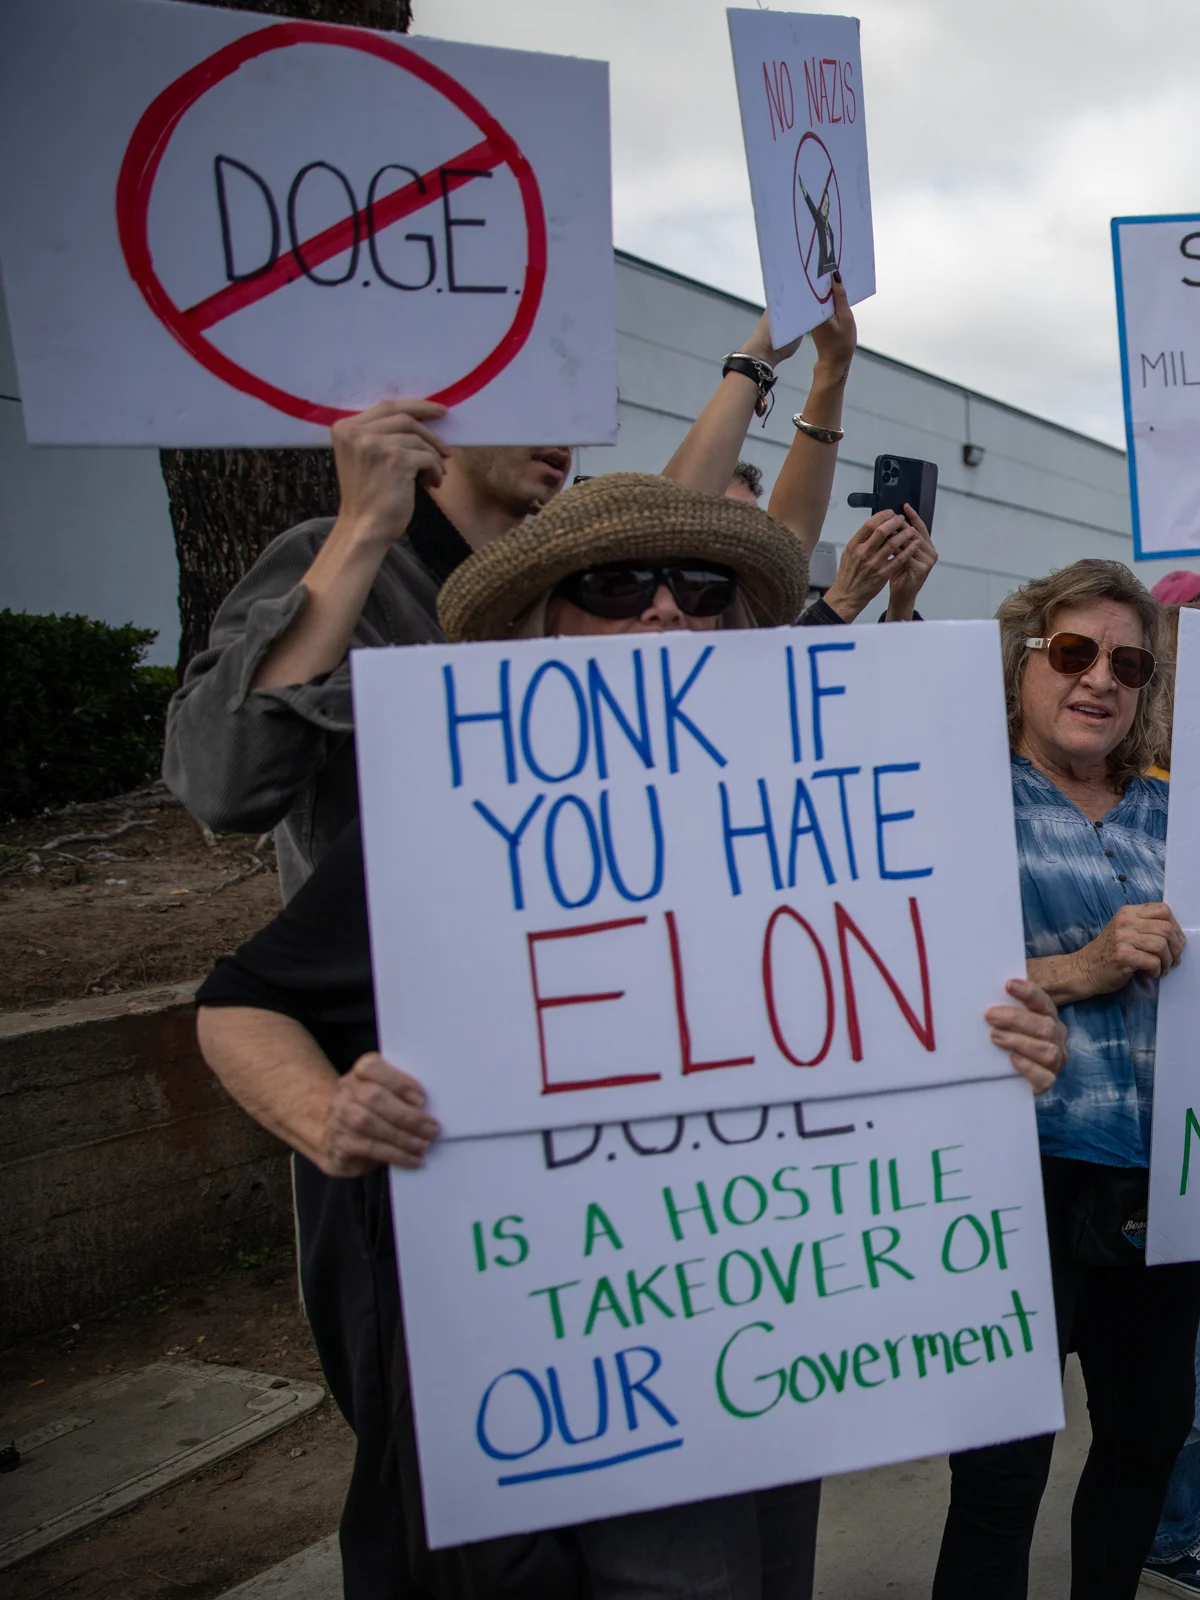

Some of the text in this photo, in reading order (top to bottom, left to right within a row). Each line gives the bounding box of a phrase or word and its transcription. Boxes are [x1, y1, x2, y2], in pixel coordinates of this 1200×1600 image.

[763, 56, 856, 141] NO NAZIS
[213, 153, 522, 296] D.O.G.E.
[443, 641, 856, 789] HONK IF
[473, 761, 934, 911] YOU HATE
[525, 896, 936, 1095] ELON
[472, 1145, 972, 1273] IS A HOSTILE
[529, 1206, 1022, 1339] TAKEOVER OF
[476, 1290, 1038, 1462] OUR Goverment
